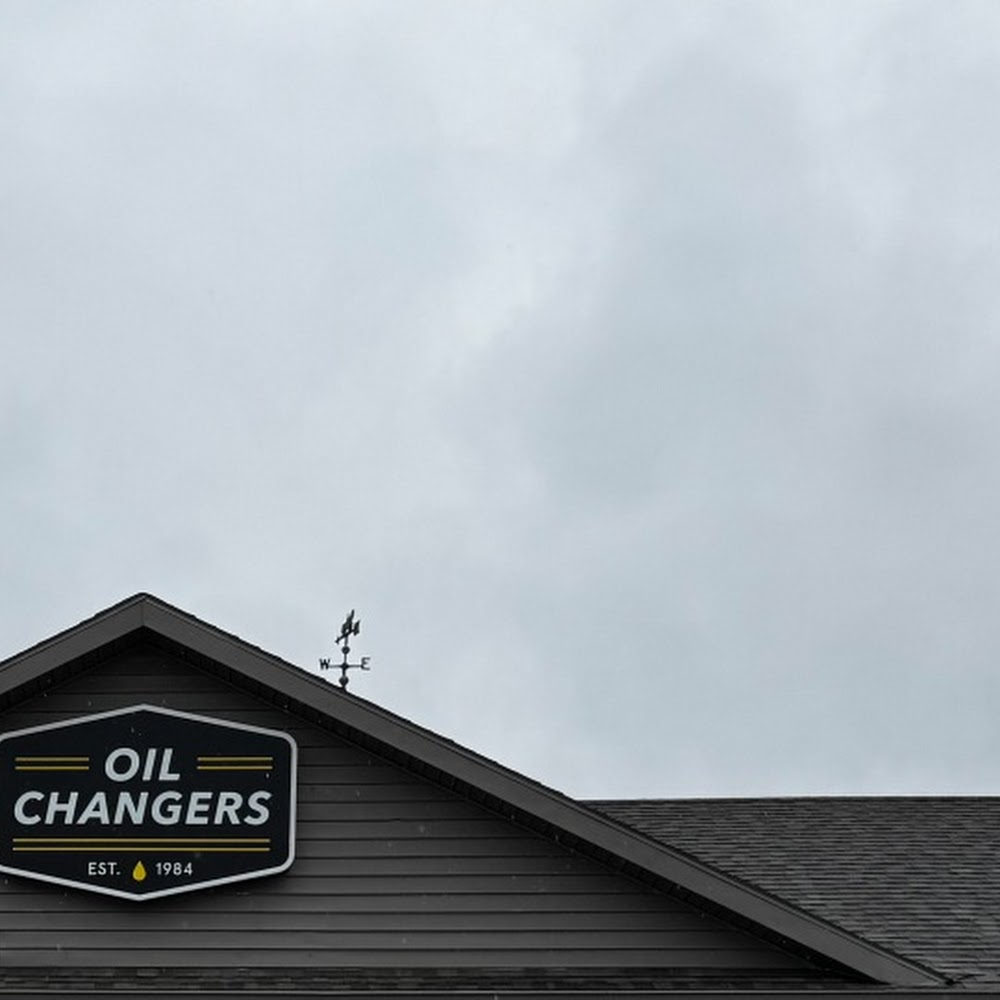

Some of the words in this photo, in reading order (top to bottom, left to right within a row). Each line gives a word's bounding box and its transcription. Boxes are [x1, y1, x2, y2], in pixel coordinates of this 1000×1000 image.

[105, 748, 180, 782] OIL
[13, 790, 272, 825] CHANGERS
[88, 862, 121, 876] EST.
[155, 862, 193, 876] 1984
